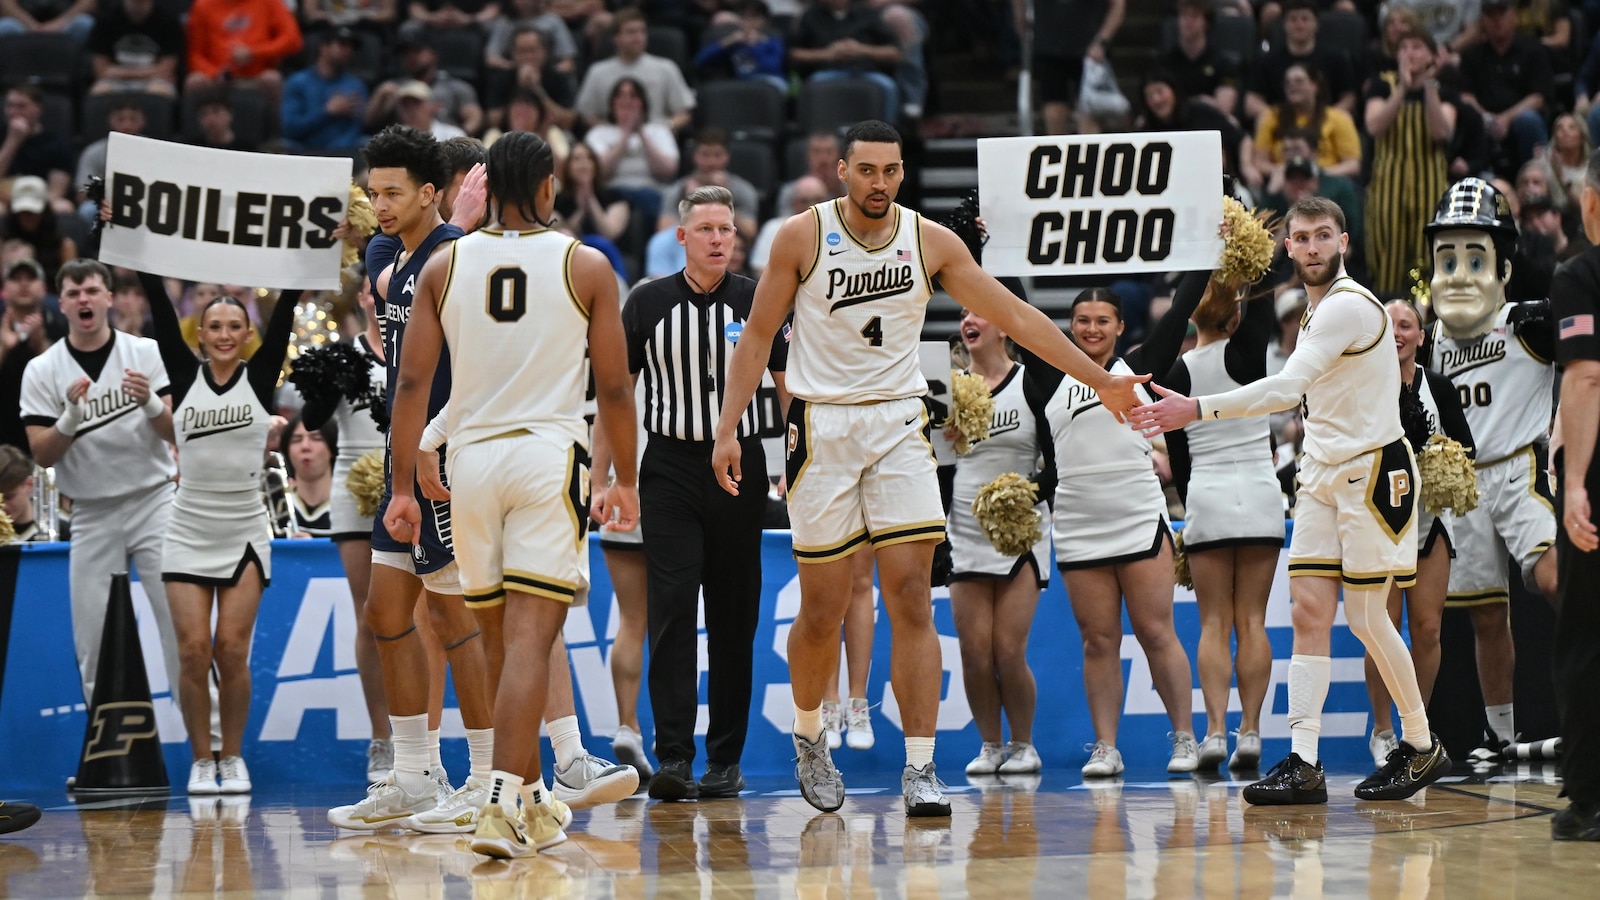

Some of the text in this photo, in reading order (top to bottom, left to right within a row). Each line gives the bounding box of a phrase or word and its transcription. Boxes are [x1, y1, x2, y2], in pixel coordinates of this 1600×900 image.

[1025, 142, 1173, 199] CHOO
[111, 172, 343, 249] BOILERS
[1026, 208, 1175, 265] CHOO
[486, 265, 527, 322] 0
[826, 262, 914, 301] Purdue
[860, 315, 883, 347] 4
[1441, 336, 1506, 375] Purdue
[1457, 382, 1492, 409] 00
[182, 403, 253, 432] Purdue
[787, 422, 799, 461] P
[1388, 469, 1410, 507] P
[84, 701, 158, 762] P
